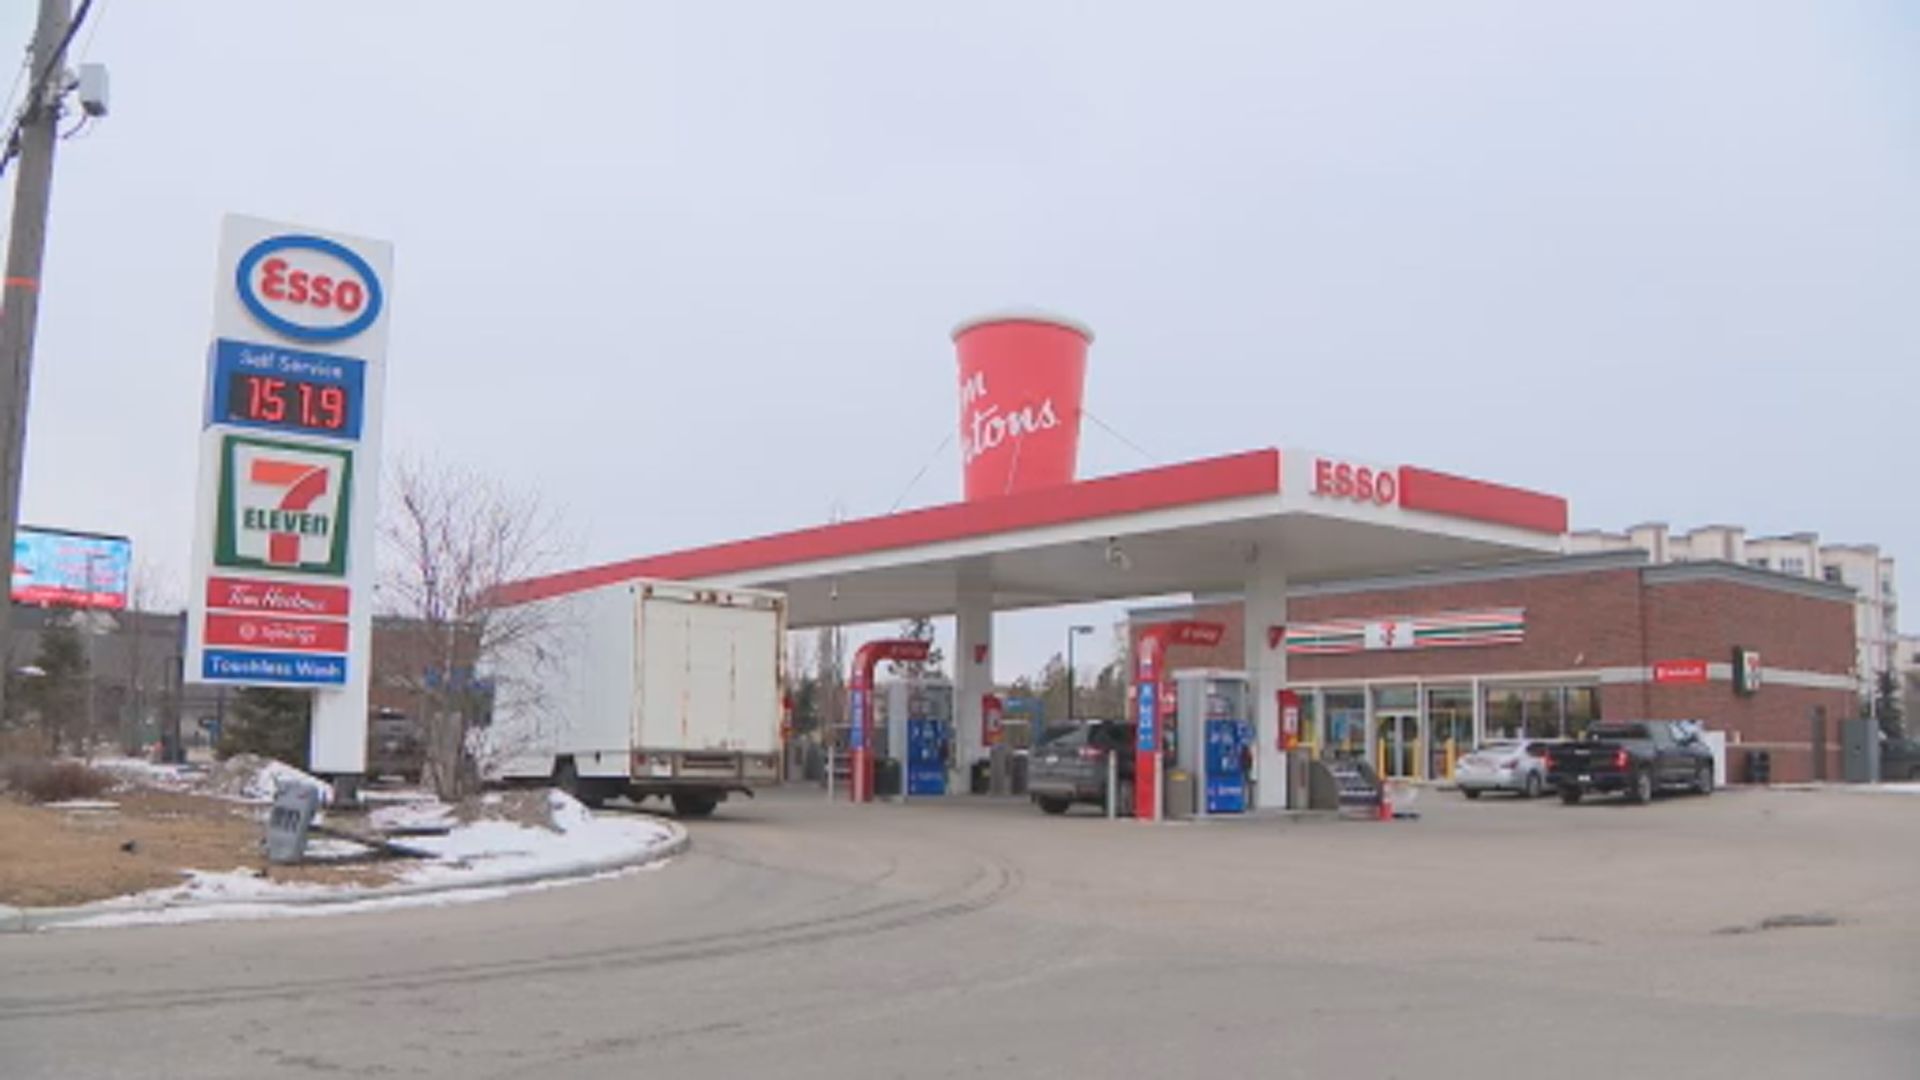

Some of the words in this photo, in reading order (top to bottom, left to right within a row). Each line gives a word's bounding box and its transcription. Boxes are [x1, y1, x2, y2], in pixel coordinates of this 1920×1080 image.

[260, 258, 363, 314] Esso
[248, 377, 344, 430] 151.9
[963, 398, 1061, 464] tons
[1315, 458, 1397, 503] ESSO
[249, 458, 329, 563] 7
[209, 655, 293, 676] Touchless
[295, 660, 342, 677] Wash
